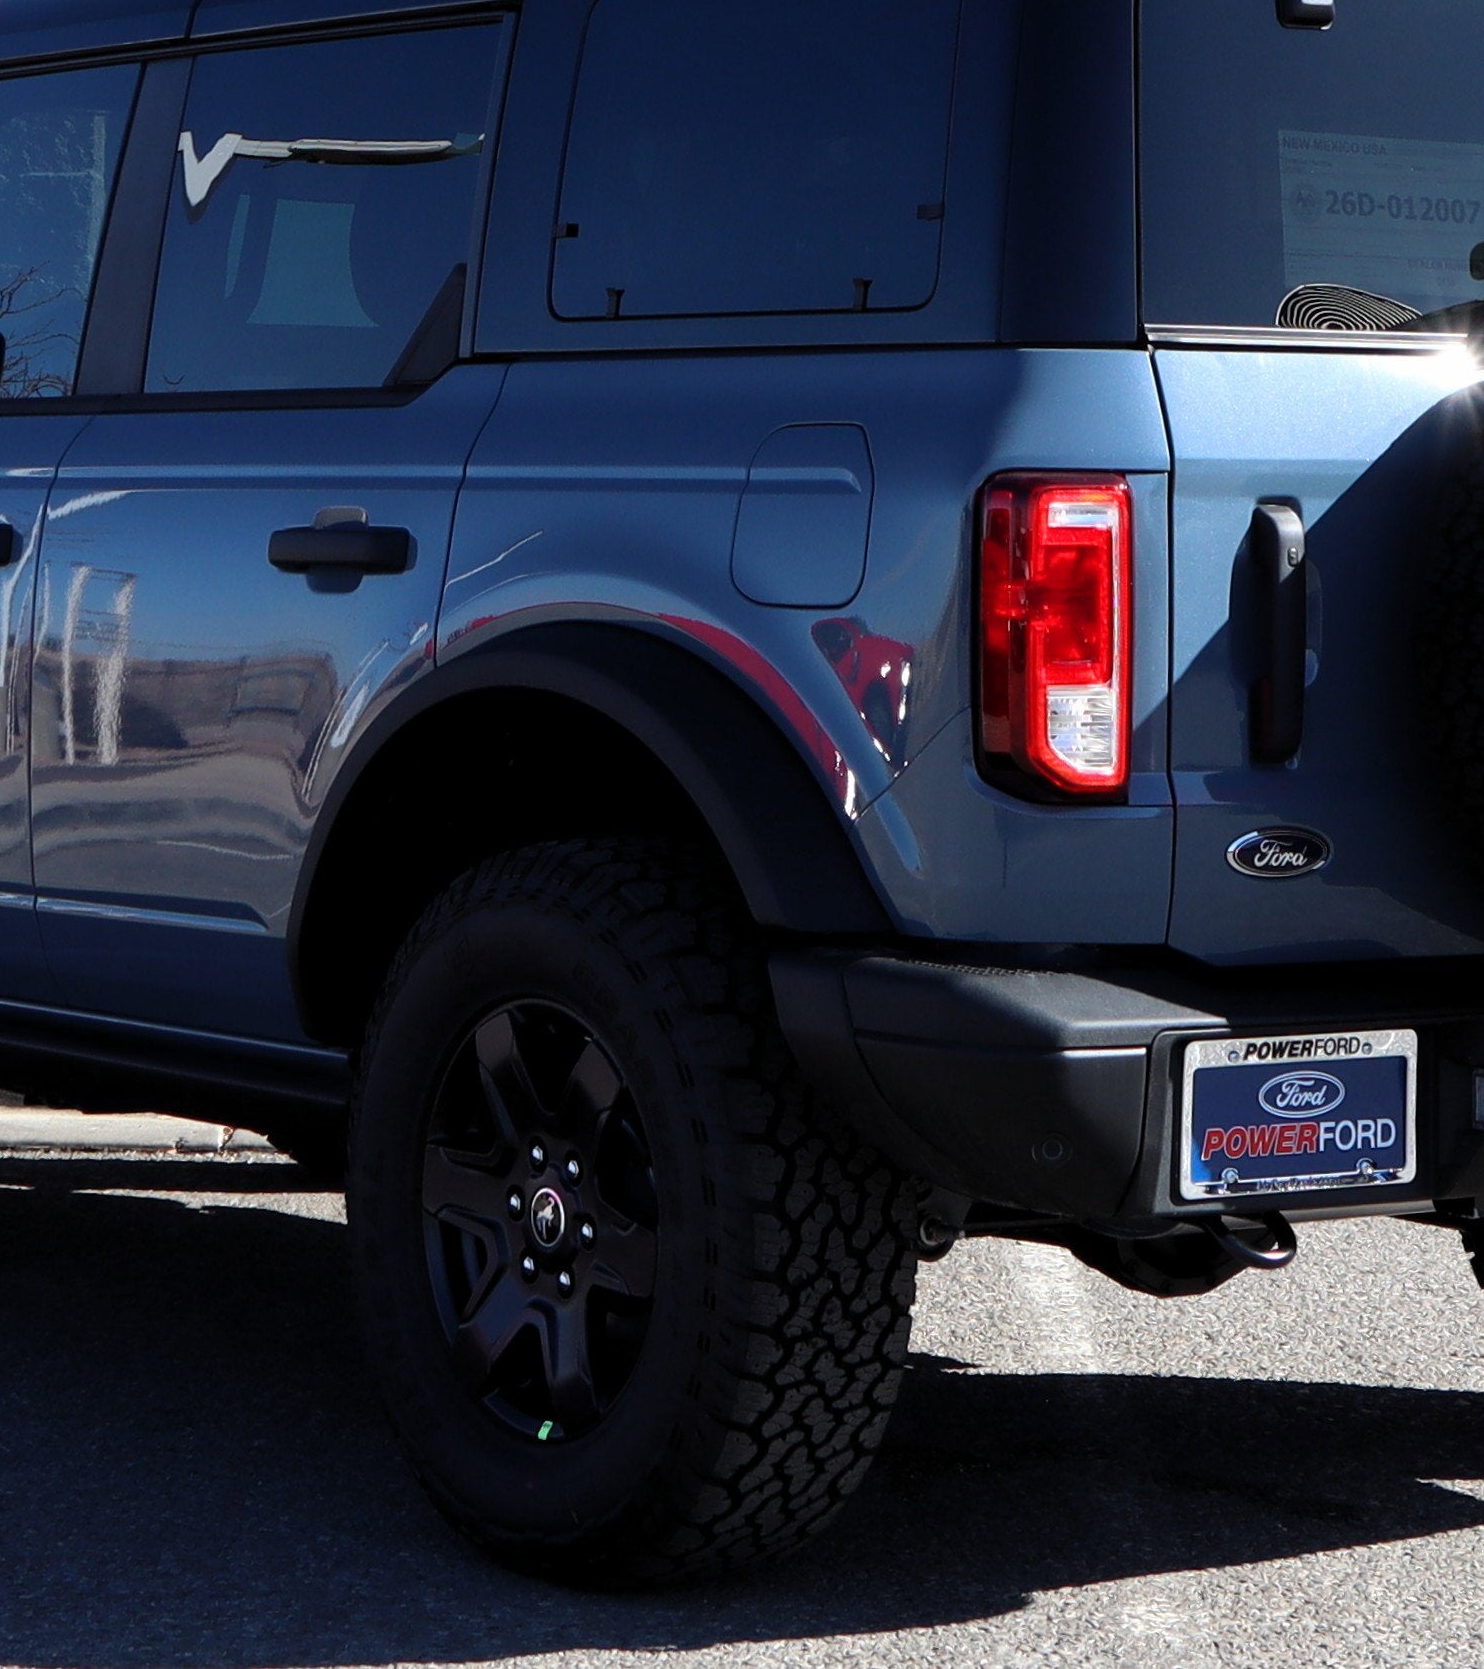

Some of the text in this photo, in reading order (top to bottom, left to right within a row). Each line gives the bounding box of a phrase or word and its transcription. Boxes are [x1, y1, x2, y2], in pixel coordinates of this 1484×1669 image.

[1282, 136, 1388, 156] NEW MEXICO USA
[1324, 189, 1481, 224] 26D-012007
[1253, 837, 1308, 868] Ford
[1242, 1036, 1361, 1061] POWERFORD
[1275, 1077, 1328, 1108] Ford
[1200, 1117, 1397, 1162] POWERFORD
